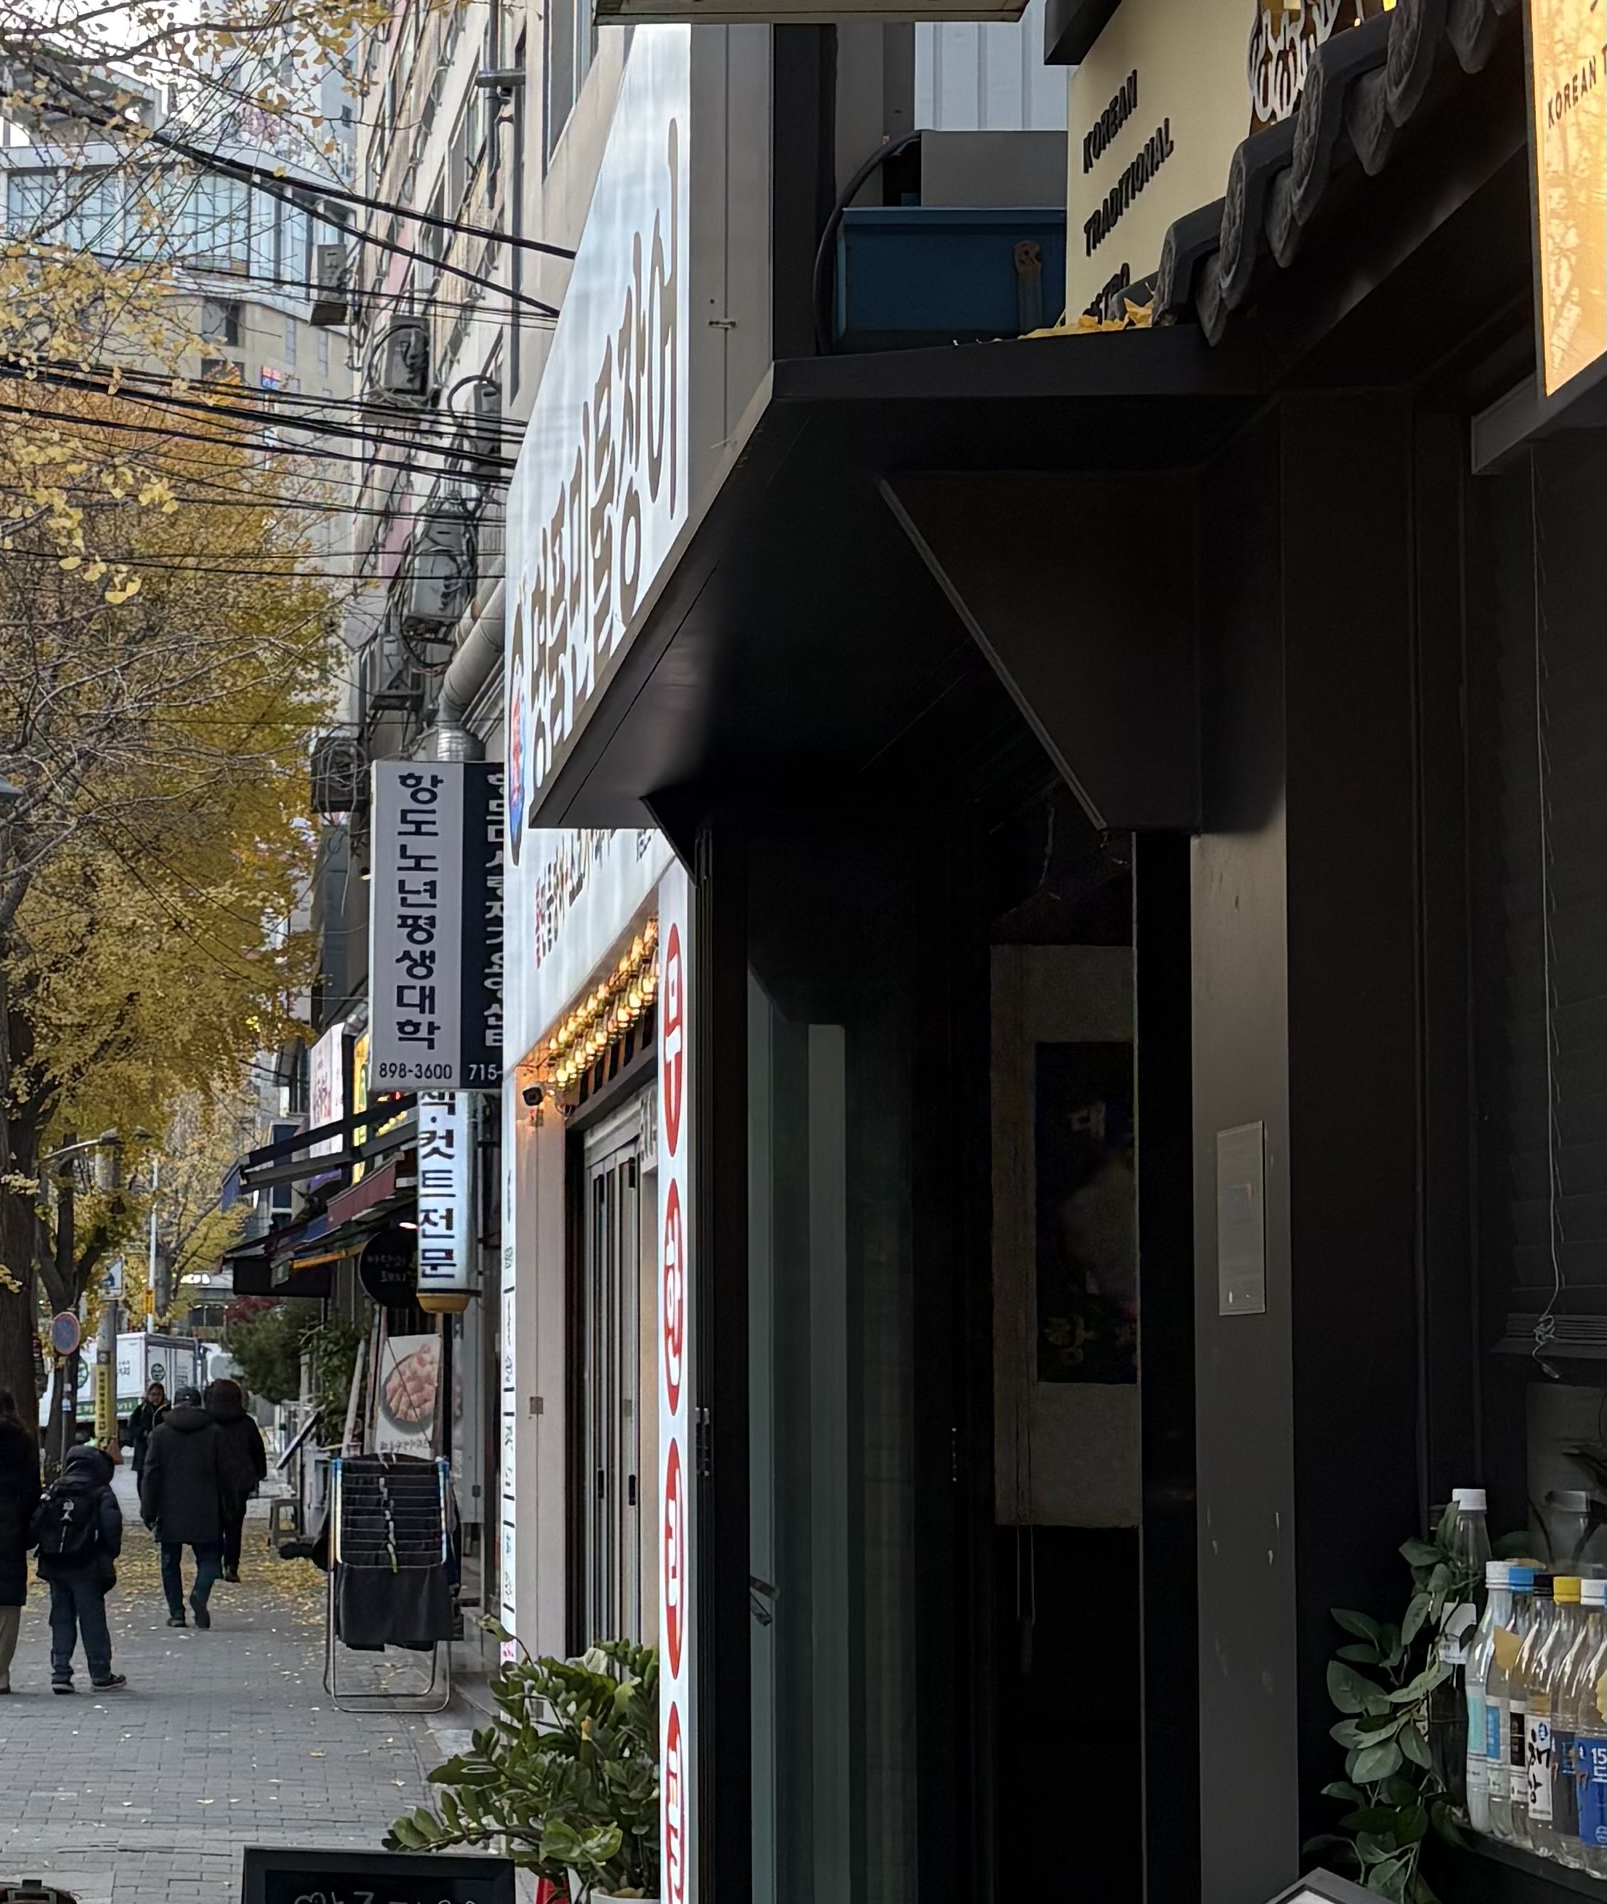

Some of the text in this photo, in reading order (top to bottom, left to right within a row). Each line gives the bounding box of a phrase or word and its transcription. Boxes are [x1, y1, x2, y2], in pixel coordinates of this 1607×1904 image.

[1083, 69, 1137, 174] KOREAN
[1547, 55, 1597, 128] KOREAN
[1084, 117, 1174, 257] TRADITIONAL
[395, 772, 444, 1050] 항도노년평생대학
[379, 1062, 452, 1080] 898-3600
